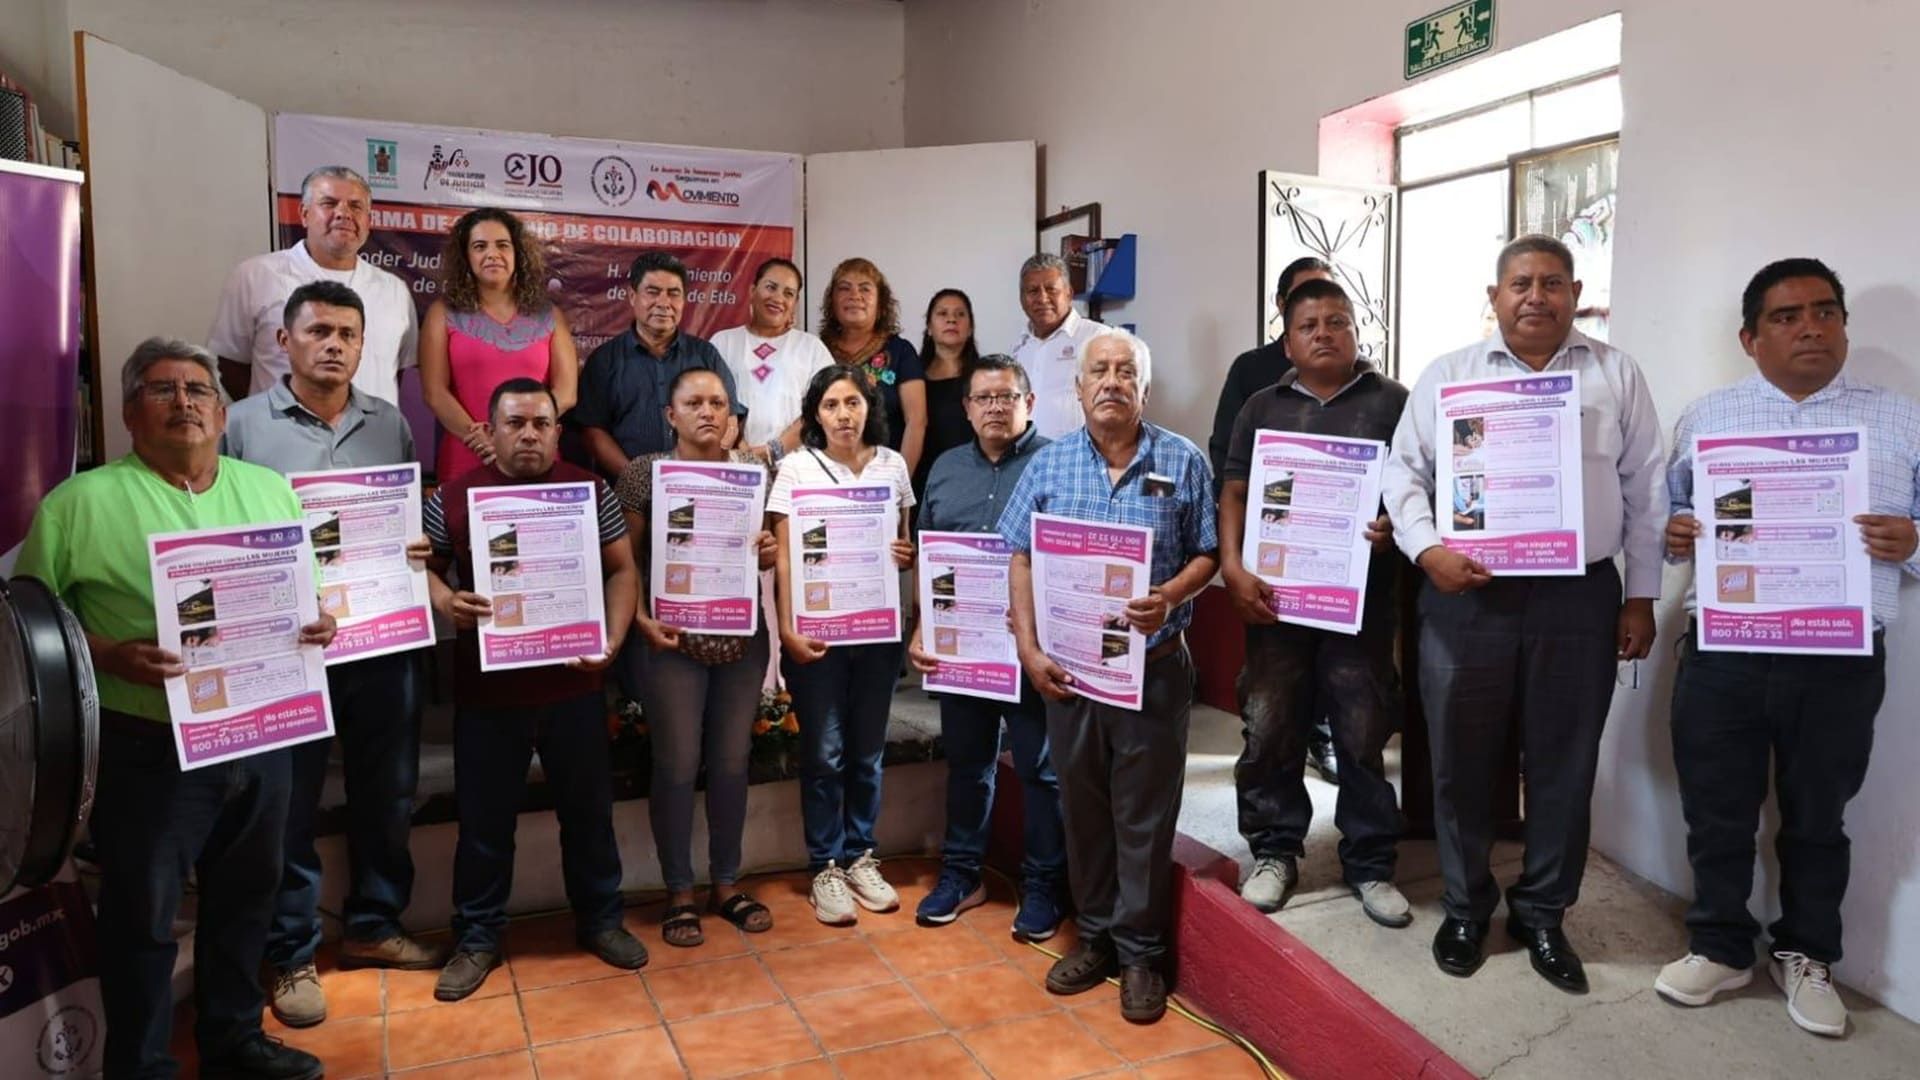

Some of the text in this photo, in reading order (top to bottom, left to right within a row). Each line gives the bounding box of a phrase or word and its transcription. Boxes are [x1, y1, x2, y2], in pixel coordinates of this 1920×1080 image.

[421, 213, 449, 232] DE
[562, 222, 588, 240] DE
[592, 224, 741, 248] COLABORACIÓN
[607, 285, 737, 305] de de Etla
